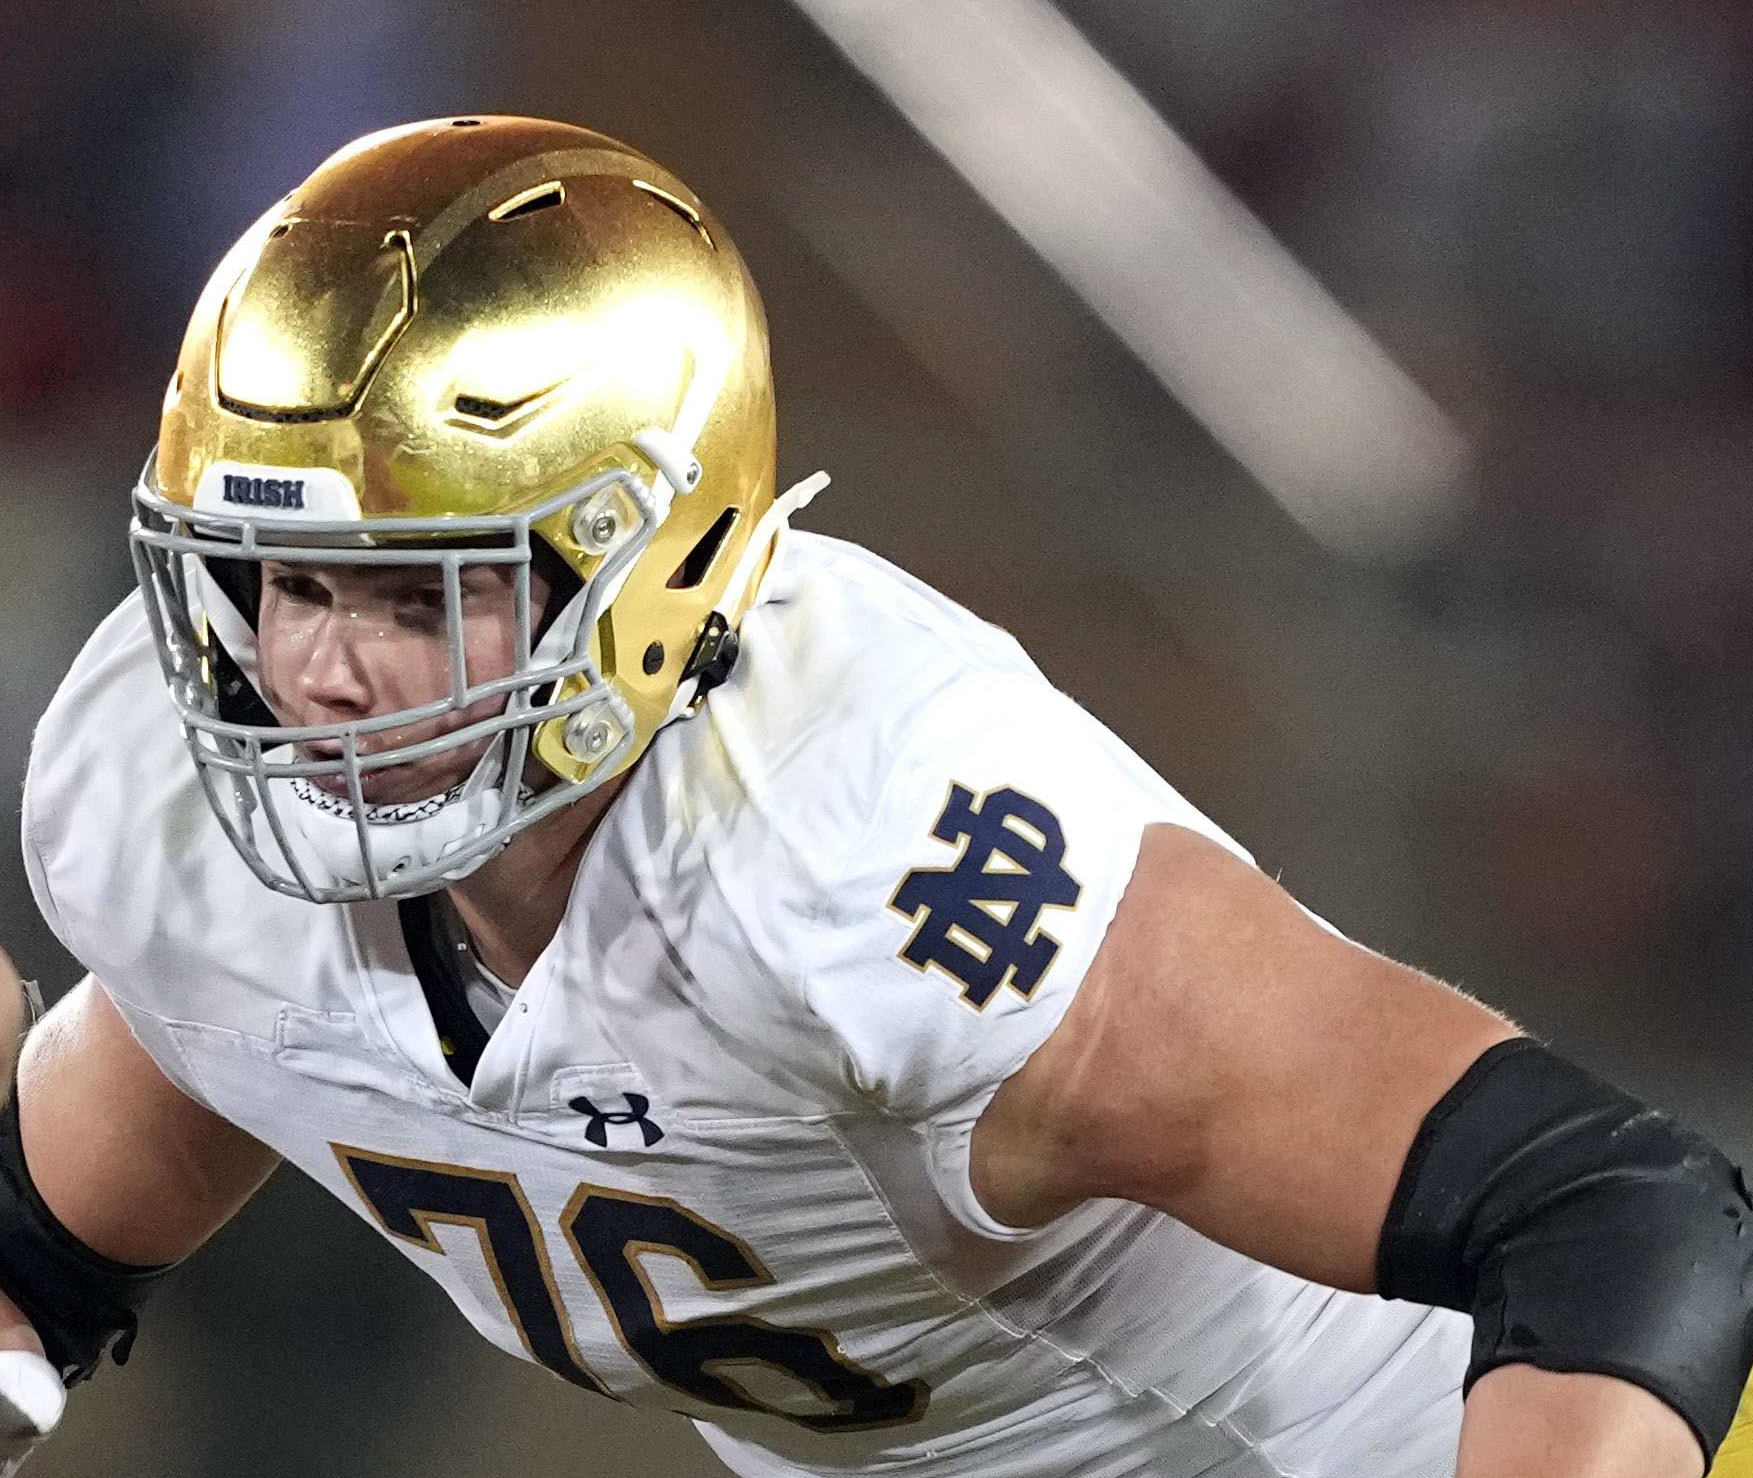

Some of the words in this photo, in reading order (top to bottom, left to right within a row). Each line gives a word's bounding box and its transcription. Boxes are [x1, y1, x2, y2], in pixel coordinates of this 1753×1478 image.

[222, 474, 305, 510] IRISH
[889, 781, 1084, 1012] ND
[330, 1142, 931, 1433] 76
